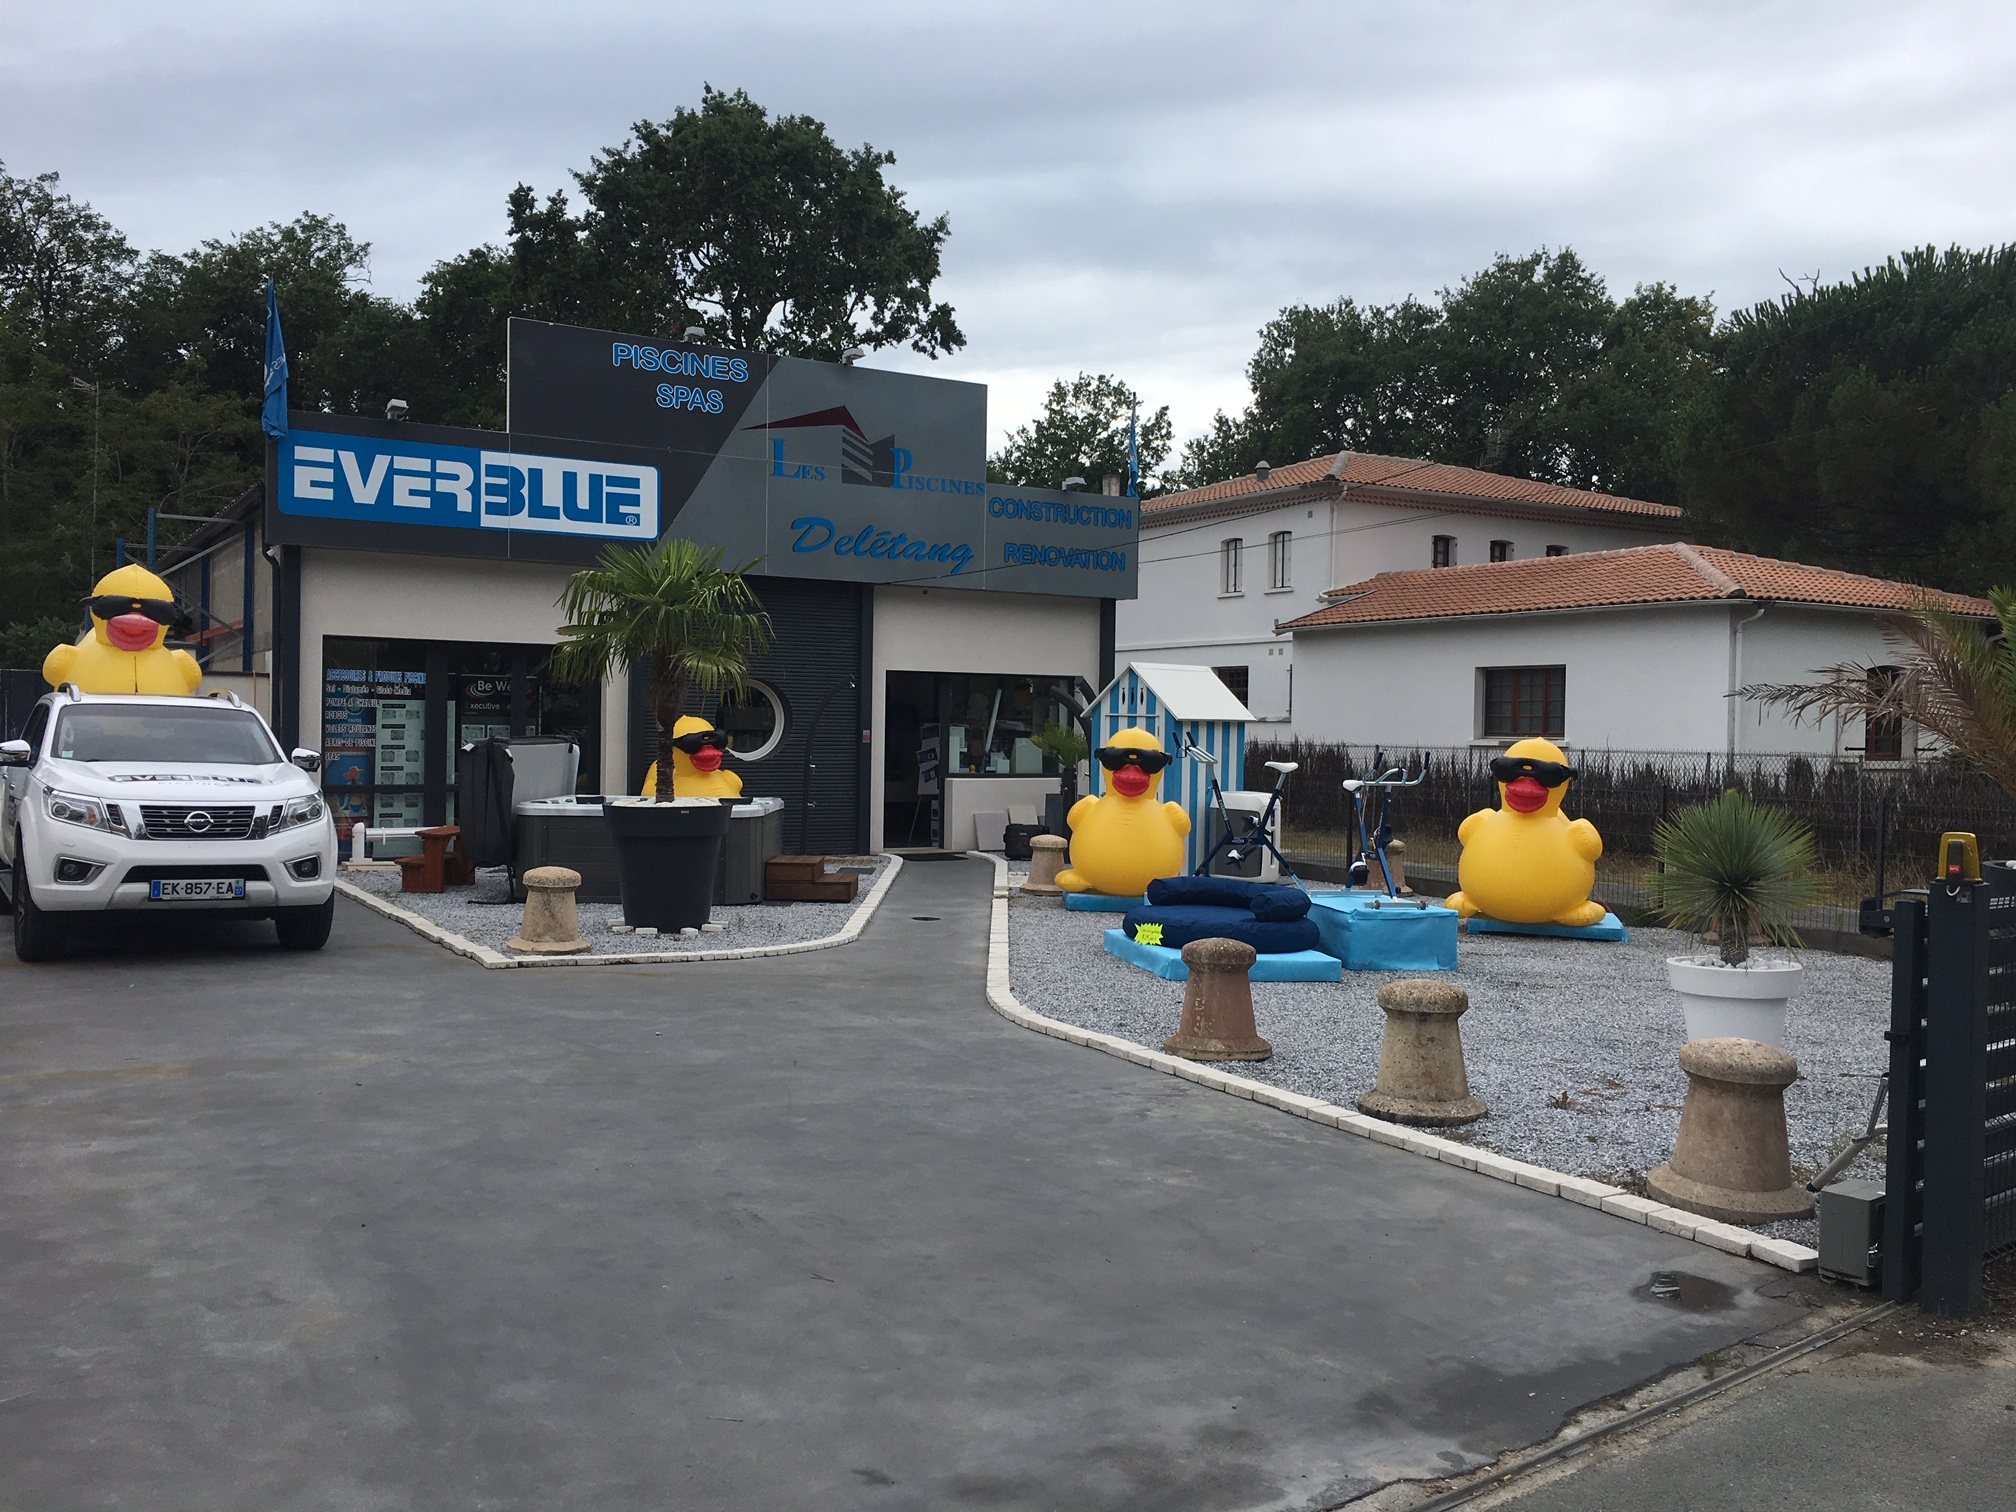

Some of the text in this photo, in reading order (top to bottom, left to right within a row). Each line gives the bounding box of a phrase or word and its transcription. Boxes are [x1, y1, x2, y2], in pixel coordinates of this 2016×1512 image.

[613, 342, 749, 382] PISCINES
[656, 383, 724, 414] SPAS
[771, 437, 986, 497] LES PISCINES
[294, 445, 641, 527] EVERBLUE
[989, 497, 1132, 530] CONSTRUCTION
[791, 516, 974, 576] Delétang
[1004, 543, 1126, 572] RENOVATION
[478, 680, 493, 691] Be
[325, 698, 346, 707] POMPE
[355, 698, 380, 708] CHALEUR
[325, 710, 348, 720] ROBOTS
[325, 723, 346, 733] VOLETS
[348, 724, 377, 734] ROULANTS
[325, 752, 340, 760] SPAS
[162, 882, 234, 895] EK-857-EA
